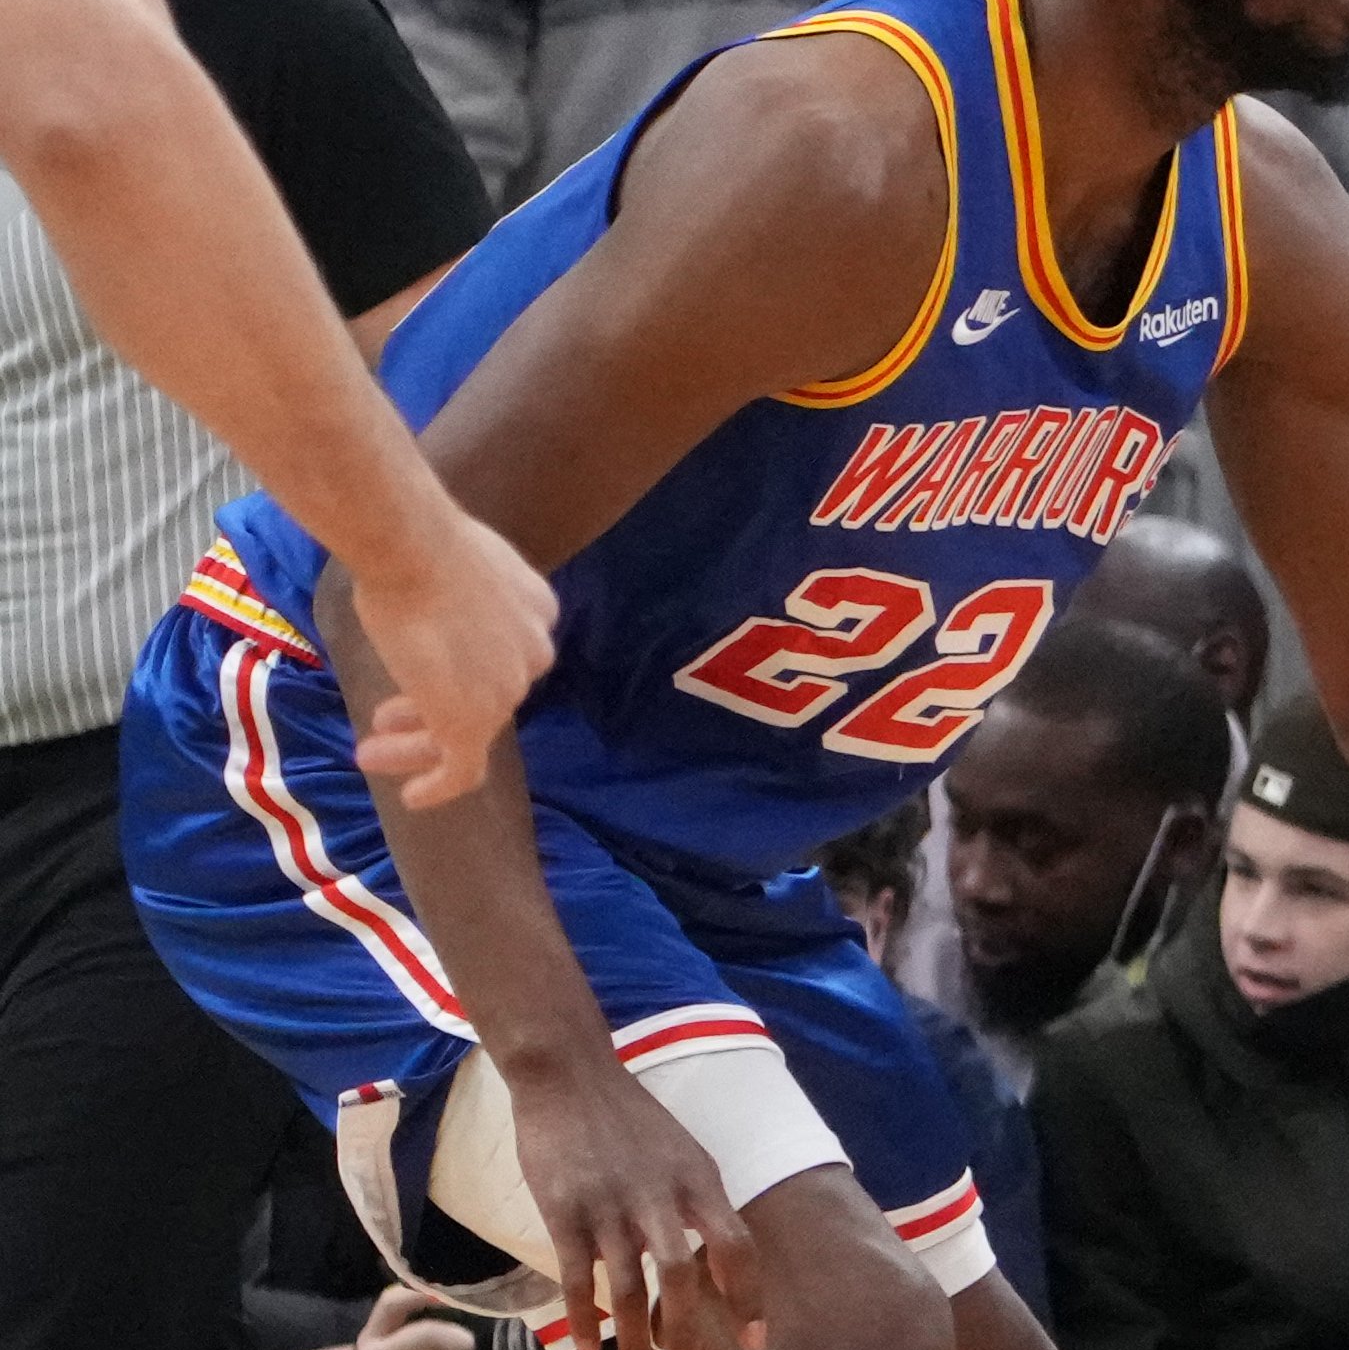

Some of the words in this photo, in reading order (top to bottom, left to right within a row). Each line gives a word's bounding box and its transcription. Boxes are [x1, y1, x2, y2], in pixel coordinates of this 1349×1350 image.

[967, 288, 1011, 324] NIKE
[1139, 296, 1219, 343] Rakuten
[673, 565, 1056, 765] 22
